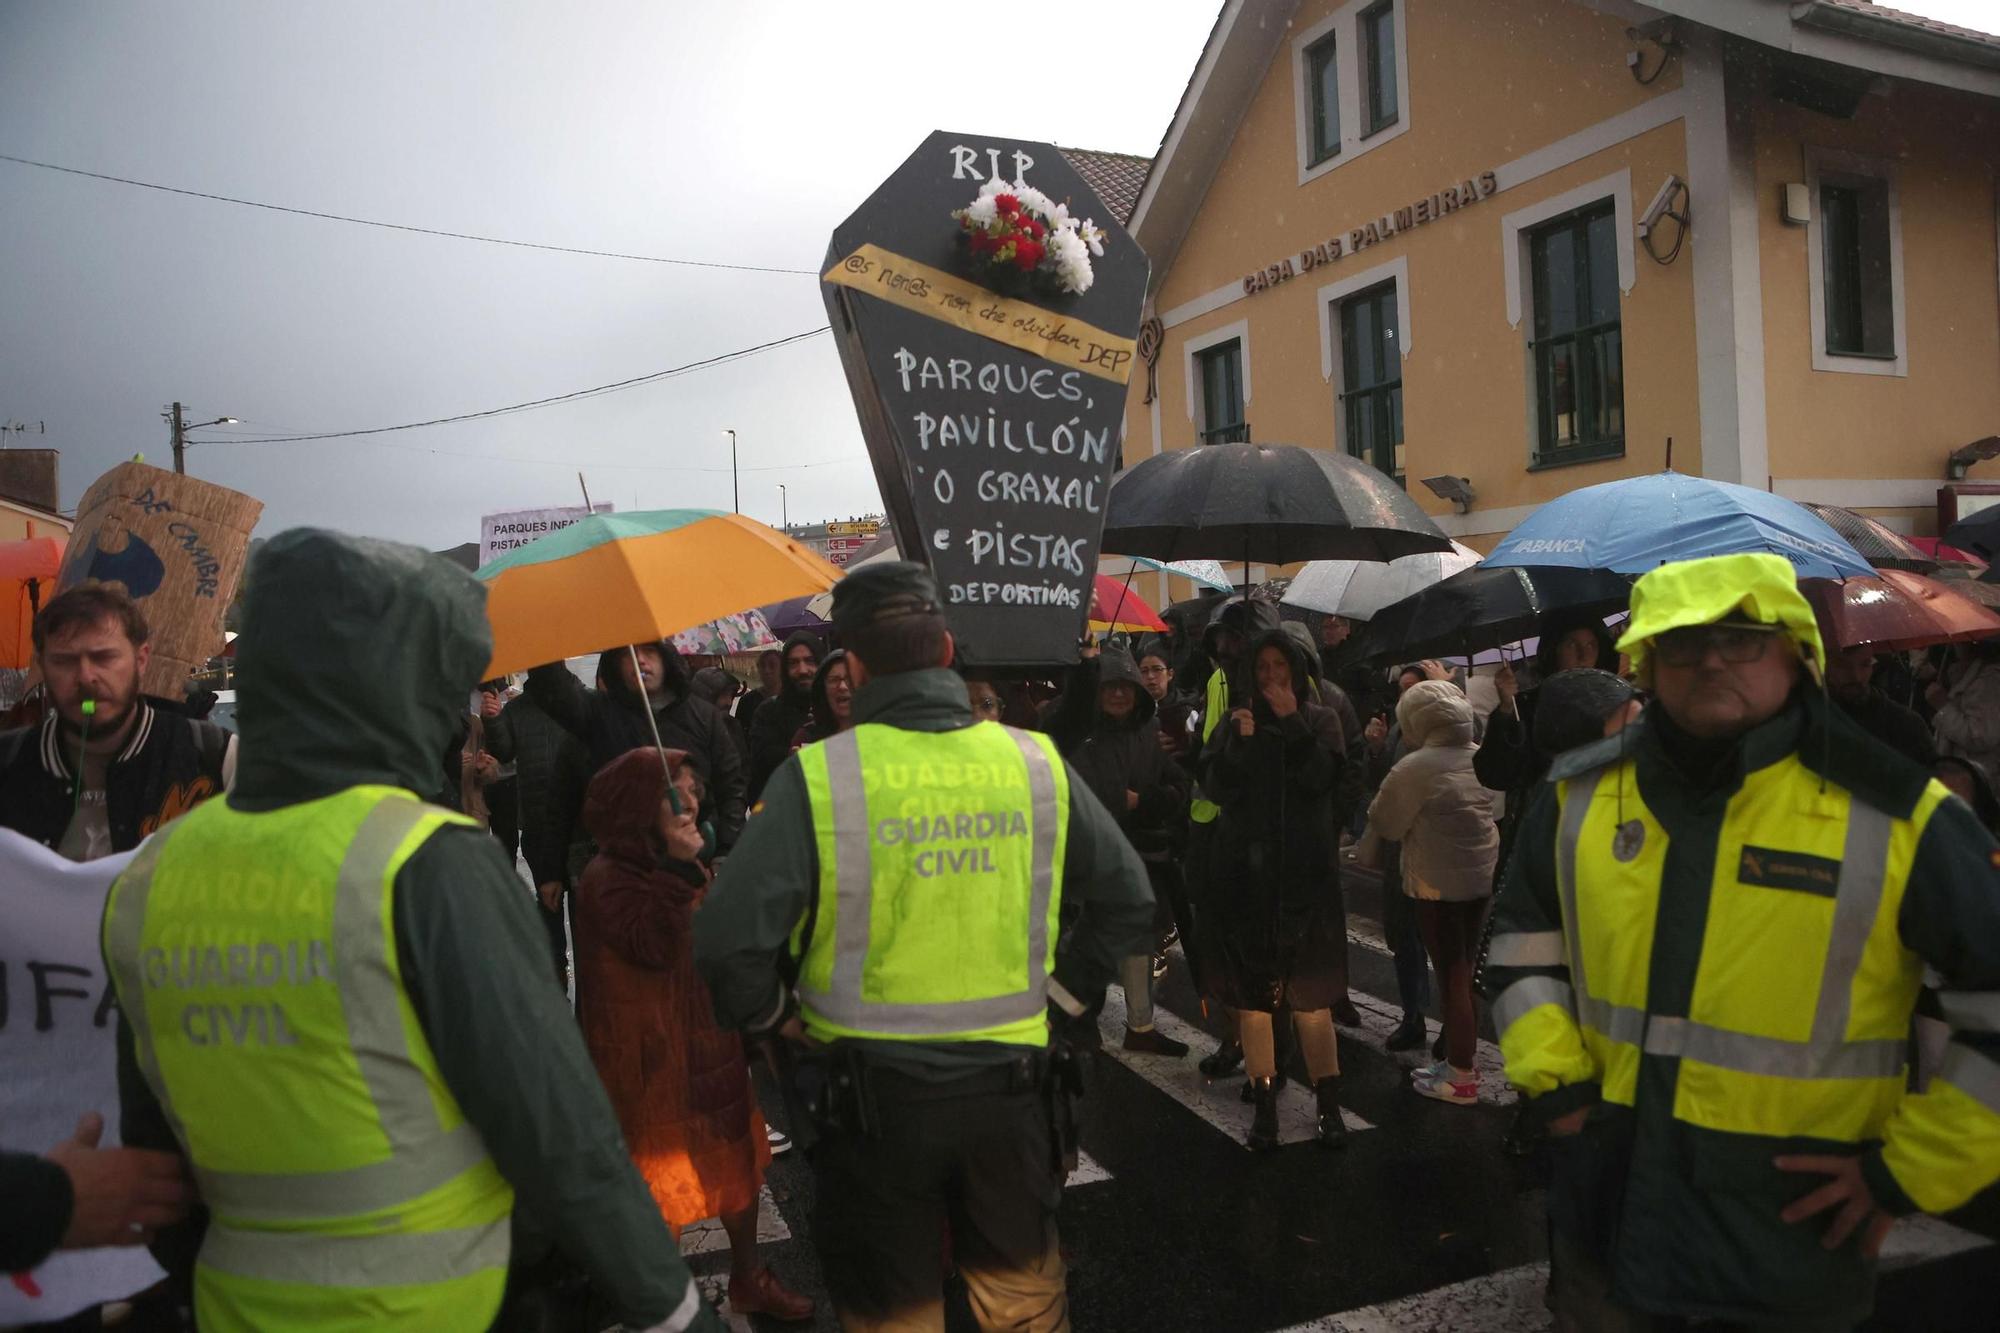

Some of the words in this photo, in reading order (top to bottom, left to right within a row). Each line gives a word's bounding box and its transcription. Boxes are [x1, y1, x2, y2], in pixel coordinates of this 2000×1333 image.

[949, 144, 1034, 184] RIP
[1243, 259, 1294, 295] CASA
[1300, 238, 1342, 272] DAS
[1350, 170, 1498, 250] PALMEIRAS
[1079, 342, 1131, 373] DEP
[894, 346, 1094, 409] PARQUES,
[494, 521, 547, 536] PARQUES
[1510, 539, 1586, 553] ABANCA
[876, 810, 1029, 846] GUARDIA
[915, 847, 996, 878] CIVIL
[144, 939, 337, 992] GUARDIA
[183, 1002, 303, 1047] CIVIL
